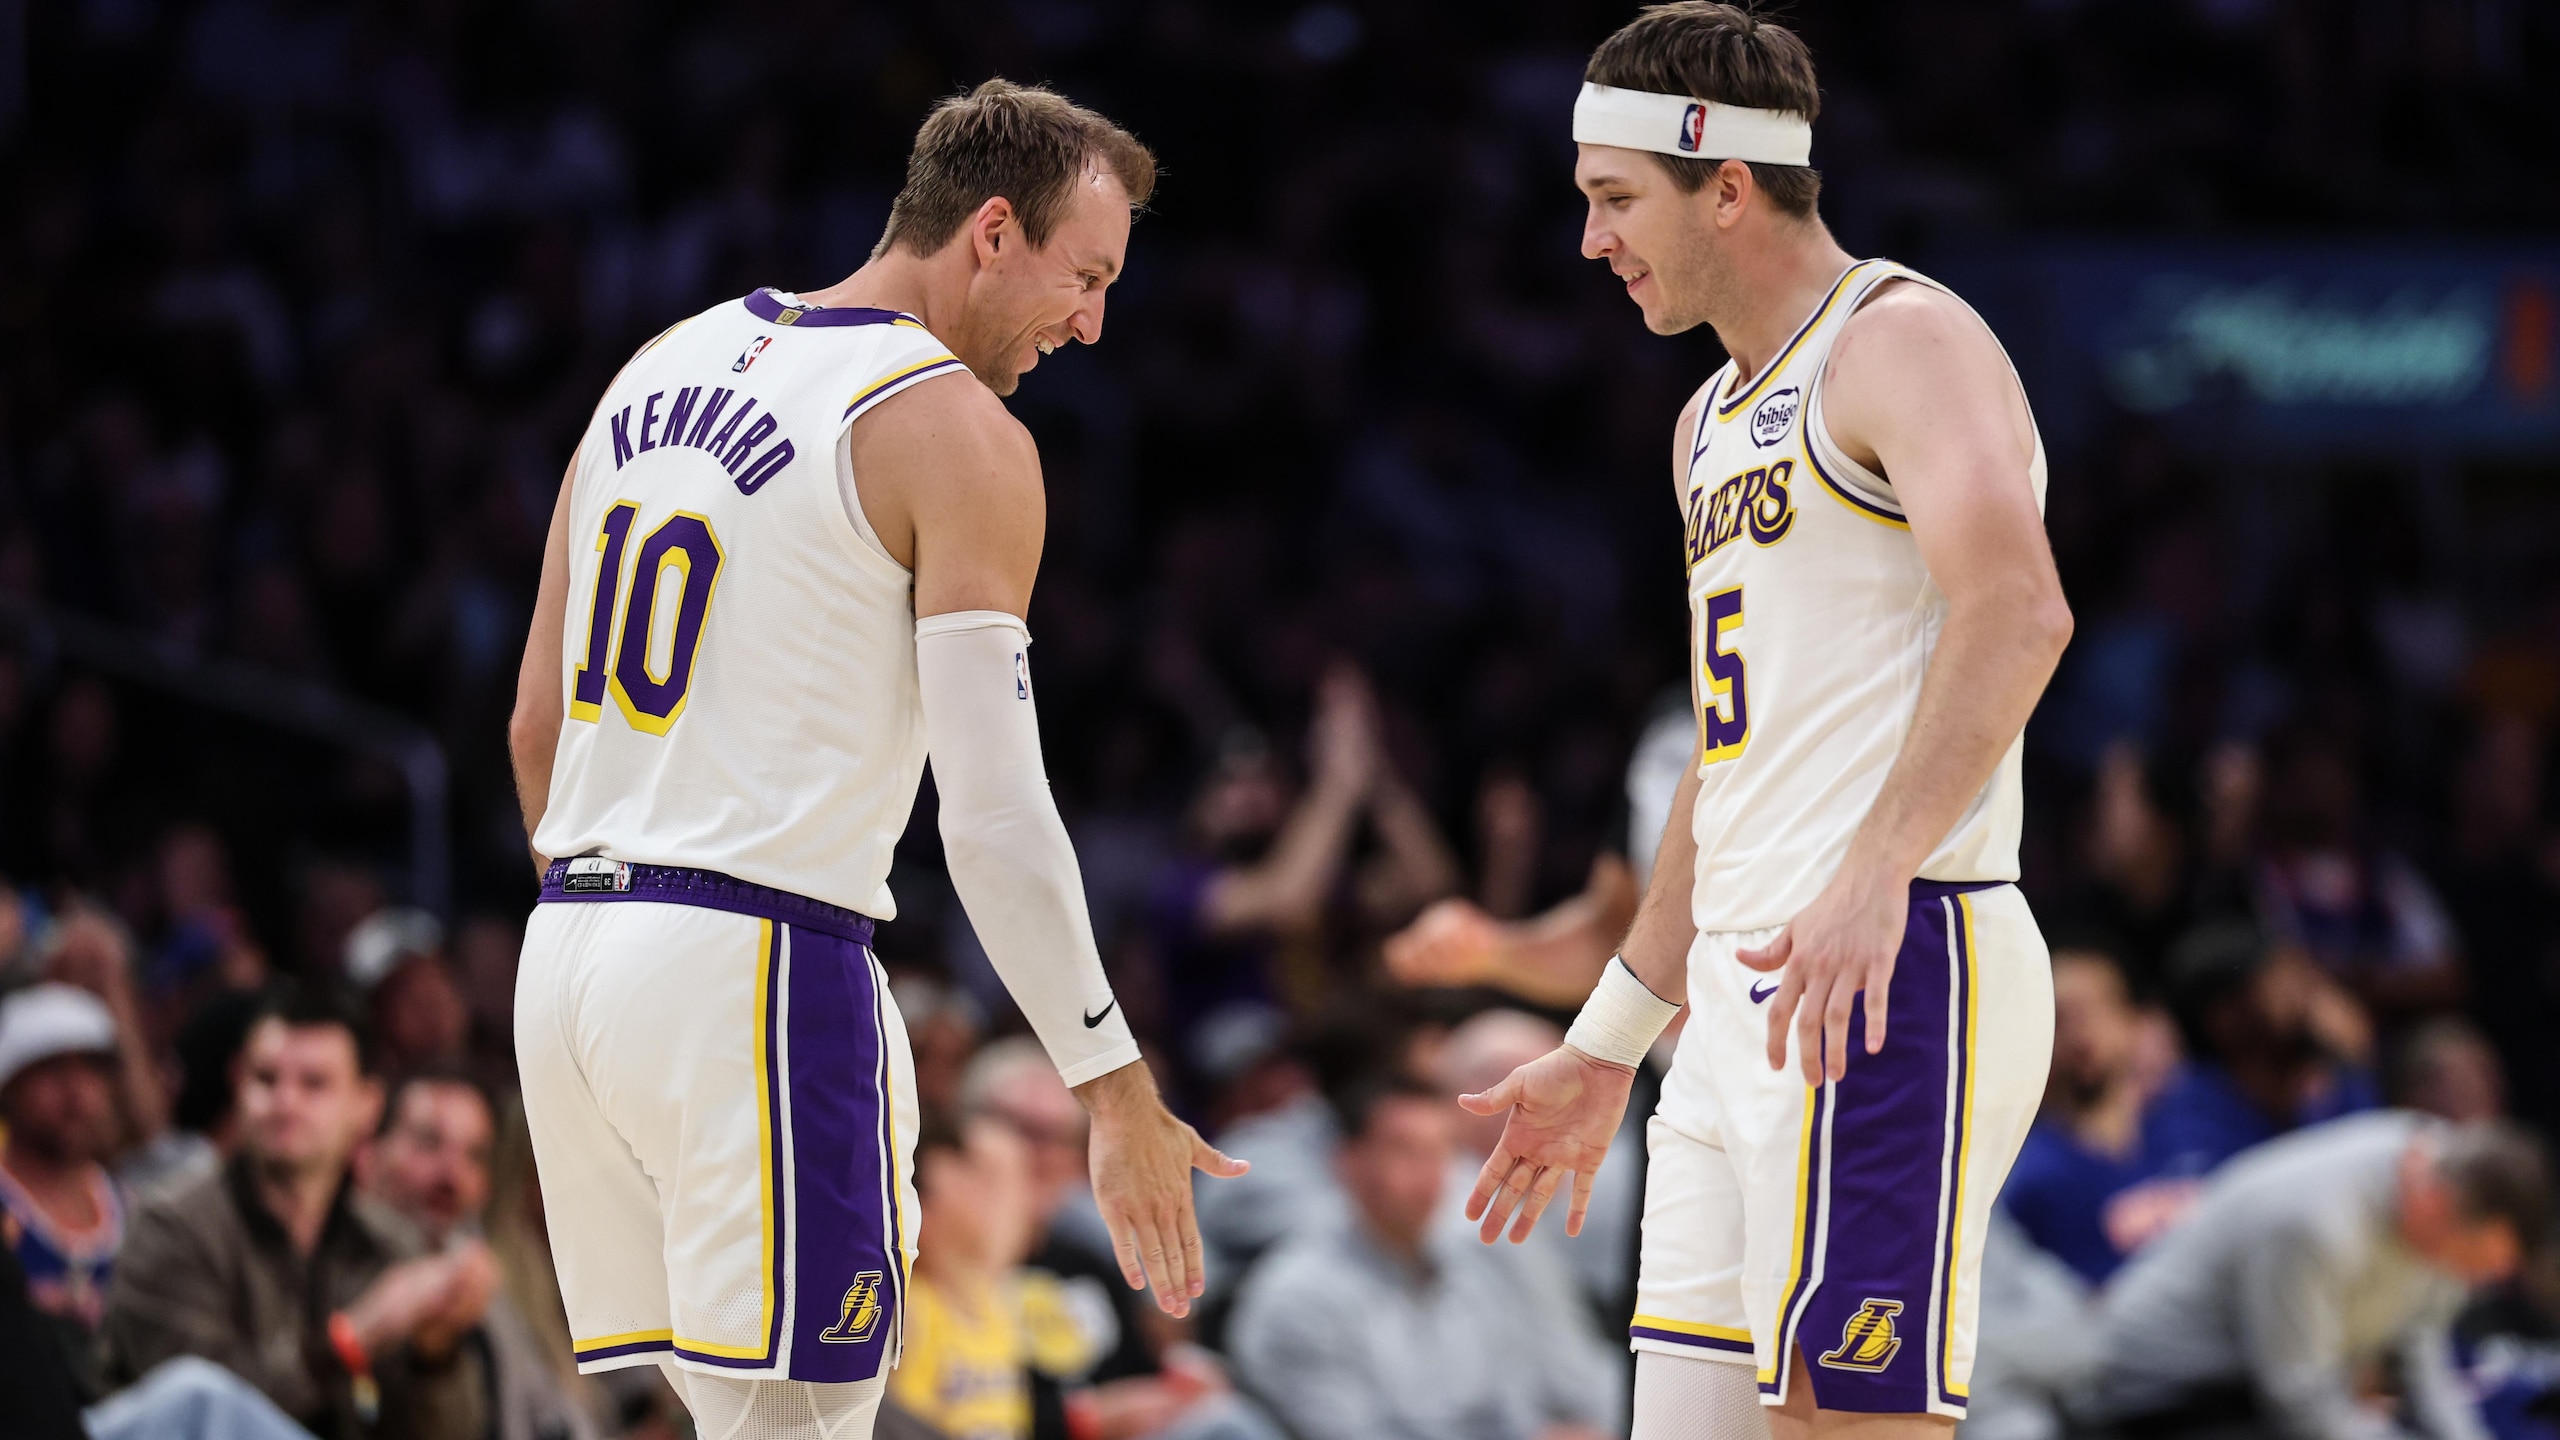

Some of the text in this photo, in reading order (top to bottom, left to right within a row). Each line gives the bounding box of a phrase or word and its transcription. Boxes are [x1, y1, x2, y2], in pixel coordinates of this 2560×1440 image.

[611, 386, 795, 496] KENNARD
[1686, 457, 1798, 572] AKERS
[570, 498, 726, 737] 10
